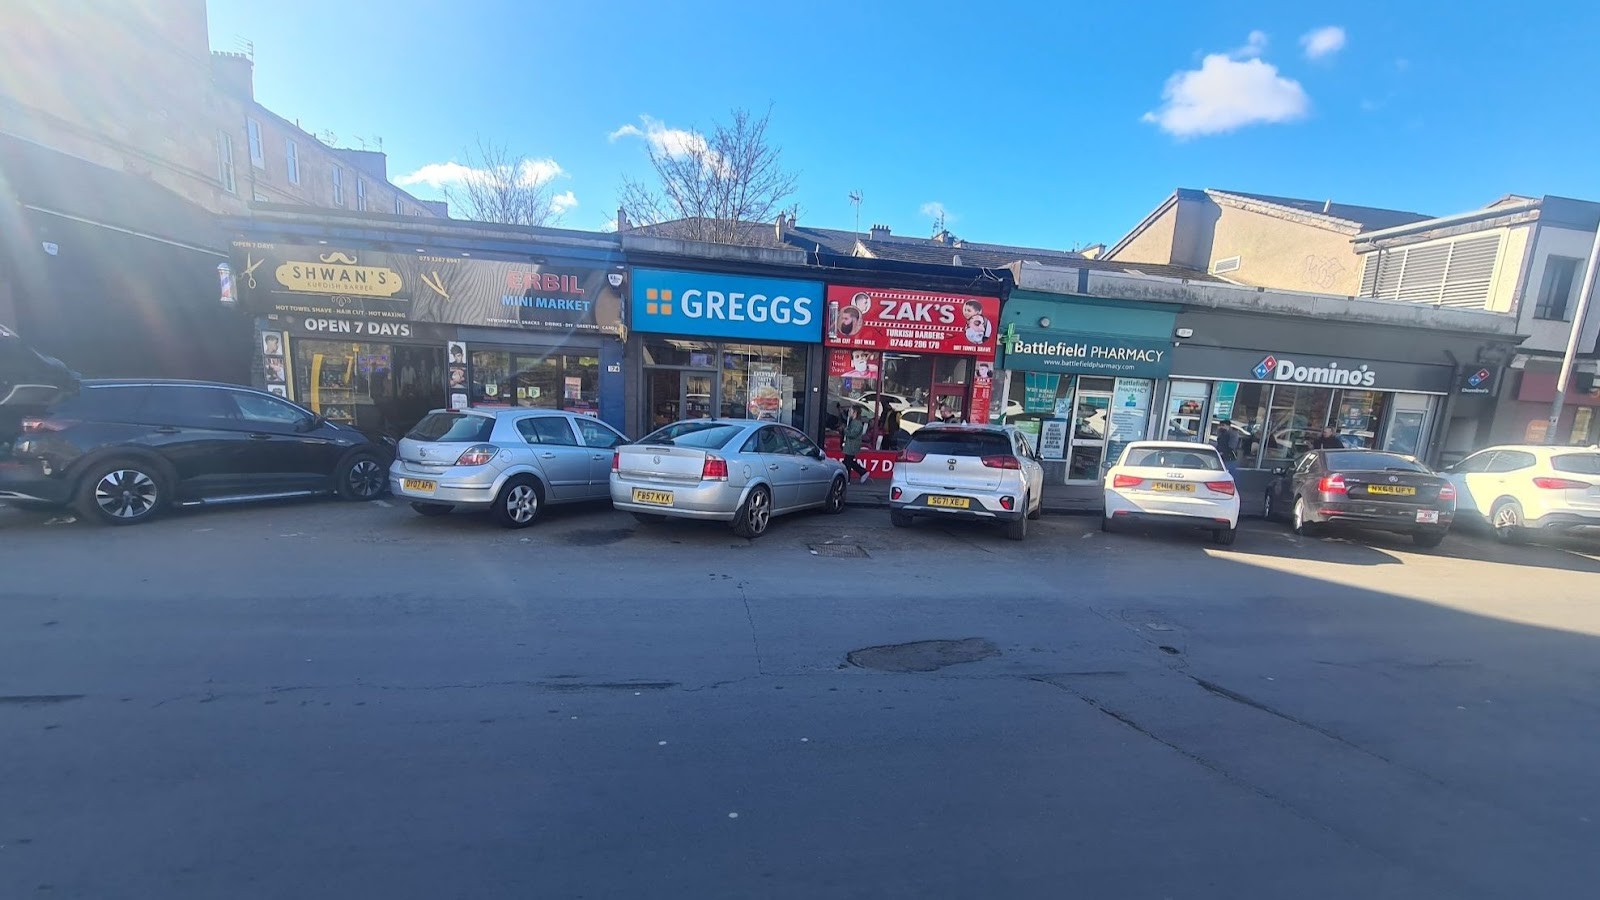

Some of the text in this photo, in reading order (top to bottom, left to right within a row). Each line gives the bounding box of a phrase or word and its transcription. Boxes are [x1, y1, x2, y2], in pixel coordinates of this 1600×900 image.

[292, 265, 387, 285] SHWAN'S
[306, 281, 374, 292] KURDISH BARBER
[506, 270, 585, 295] ERBIL
[289, 305, 311, 313] TOWEL
[312, 306, 332, 314] SHAVE
[501, 294, 591, 312] MINI MARKET
[680, 288, 812, 326] GREGGS
[878, 300, 955, 324] ZAK'S
[304, 317, 410, 336] OPEN 7 DAYS
[486, 317, 519, 325] NEWSPAPERS
[885, 328, 945, 340] TURKISH BARBERS
[1014, 340, 1164, 363] Battlefield PHARMACY
[1043, 358, 1135, 372] www.battlefieldpharmacy.com
[1274, 361, 1376, 387] Domino's
[1118, 379, 1149, 387] Battlefield
[870, 459, 880, 472] 7
[1395, 486, 1412, 494] UFY
[932, 497, 965, 507] SG71 XEJ
